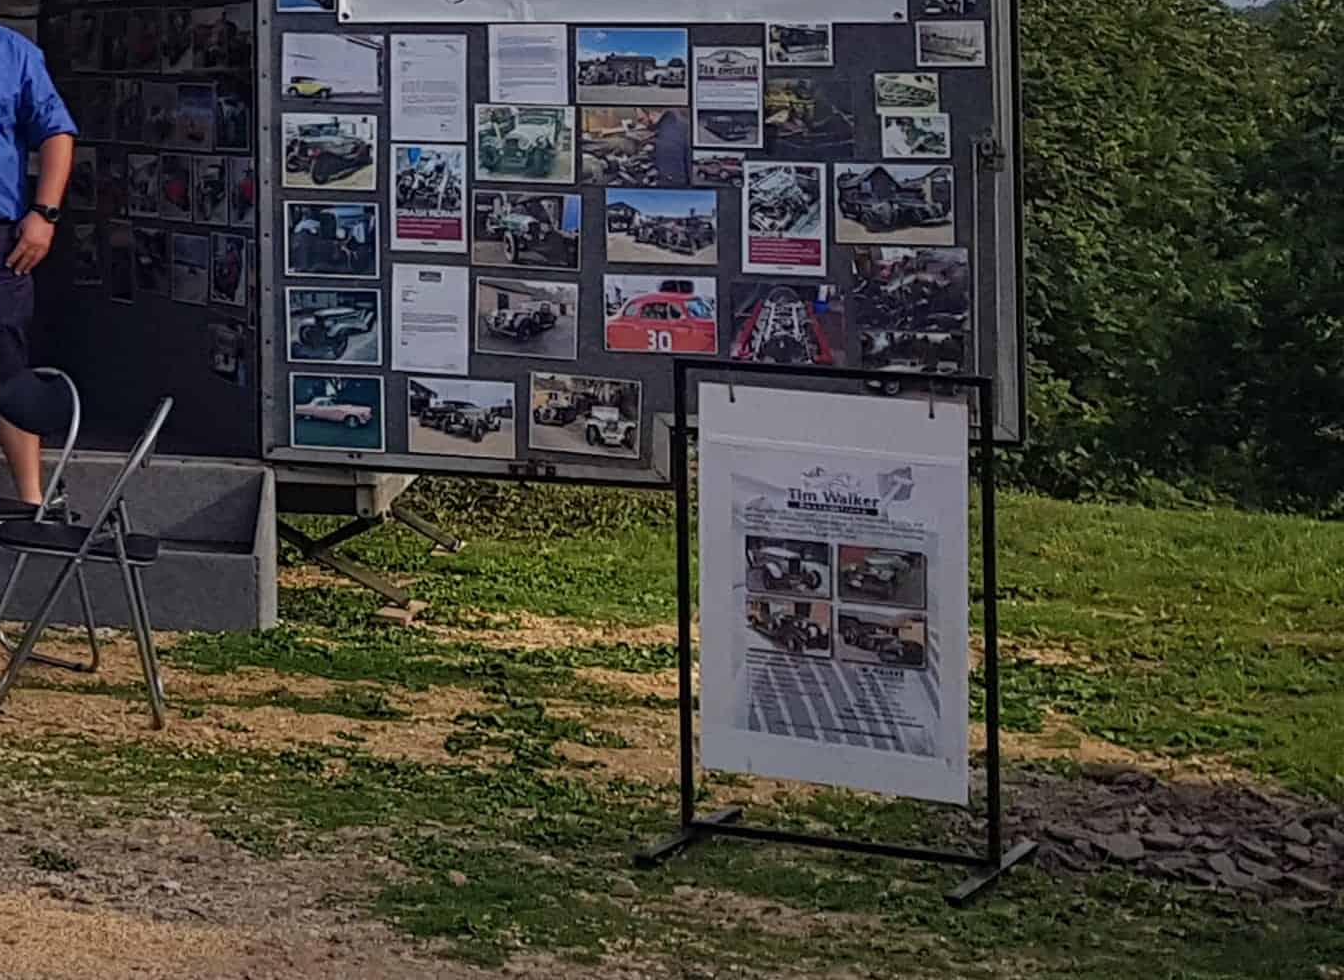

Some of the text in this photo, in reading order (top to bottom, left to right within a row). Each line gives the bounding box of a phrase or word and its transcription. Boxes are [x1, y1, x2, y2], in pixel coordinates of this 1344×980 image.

[648, 329, 672, 352] 30
[788, 486, 880, 508] Tim Walker
